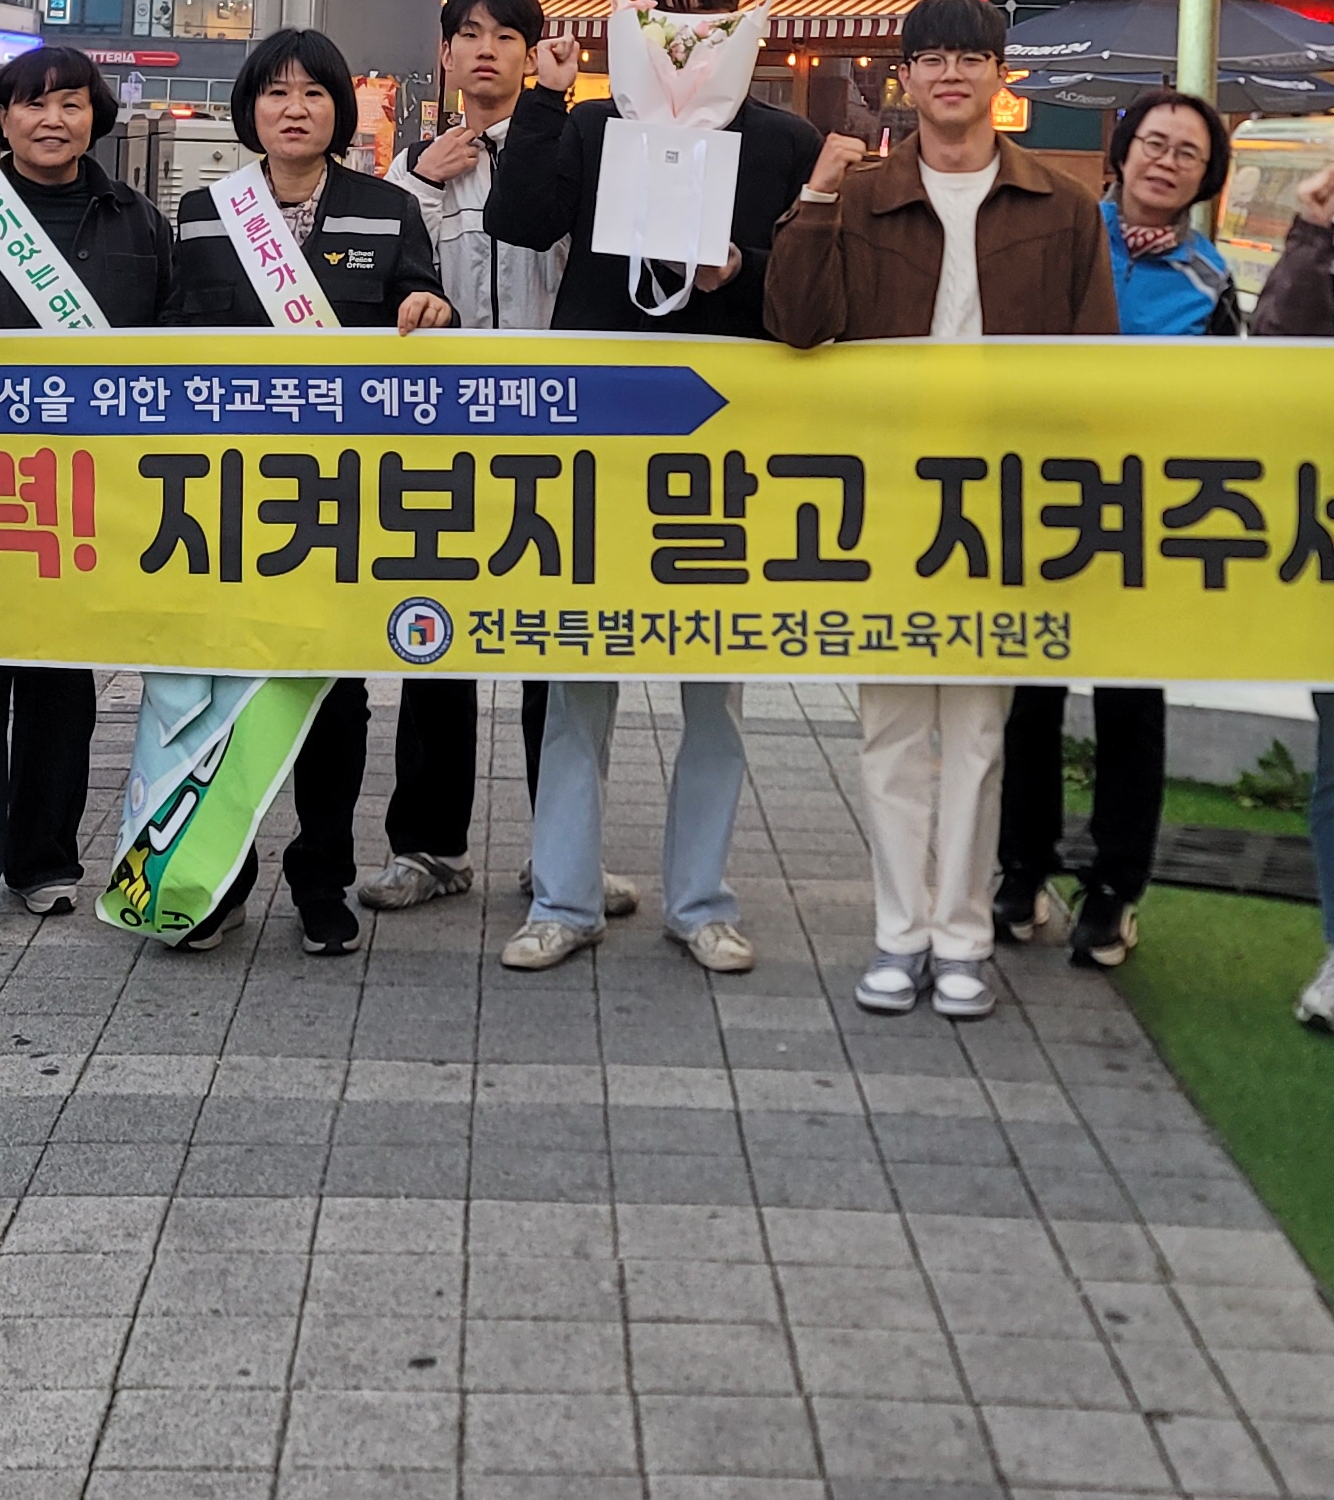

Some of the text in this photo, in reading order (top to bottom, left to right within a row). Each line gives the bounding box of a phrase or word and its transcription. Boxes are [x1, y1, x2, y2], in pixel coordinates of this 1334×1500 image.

[229, 184, 324, 329] 넌 혼자가 아
[347, 248, 375, 257] School
[348, 255, 373, 263] Police
[89, 376, 172, 422] 위한
[182, 376, 346, 422] 학교폭력
[359, 377, 444, 423] 예방
[457, 376, 580, 423] 캠페인
[137, 447, 597, 586] 지켜보지
[646, 449, 873, 586] 말고
[466, 608, 1074, 661] 전북특별자치도정읍교육지원청
